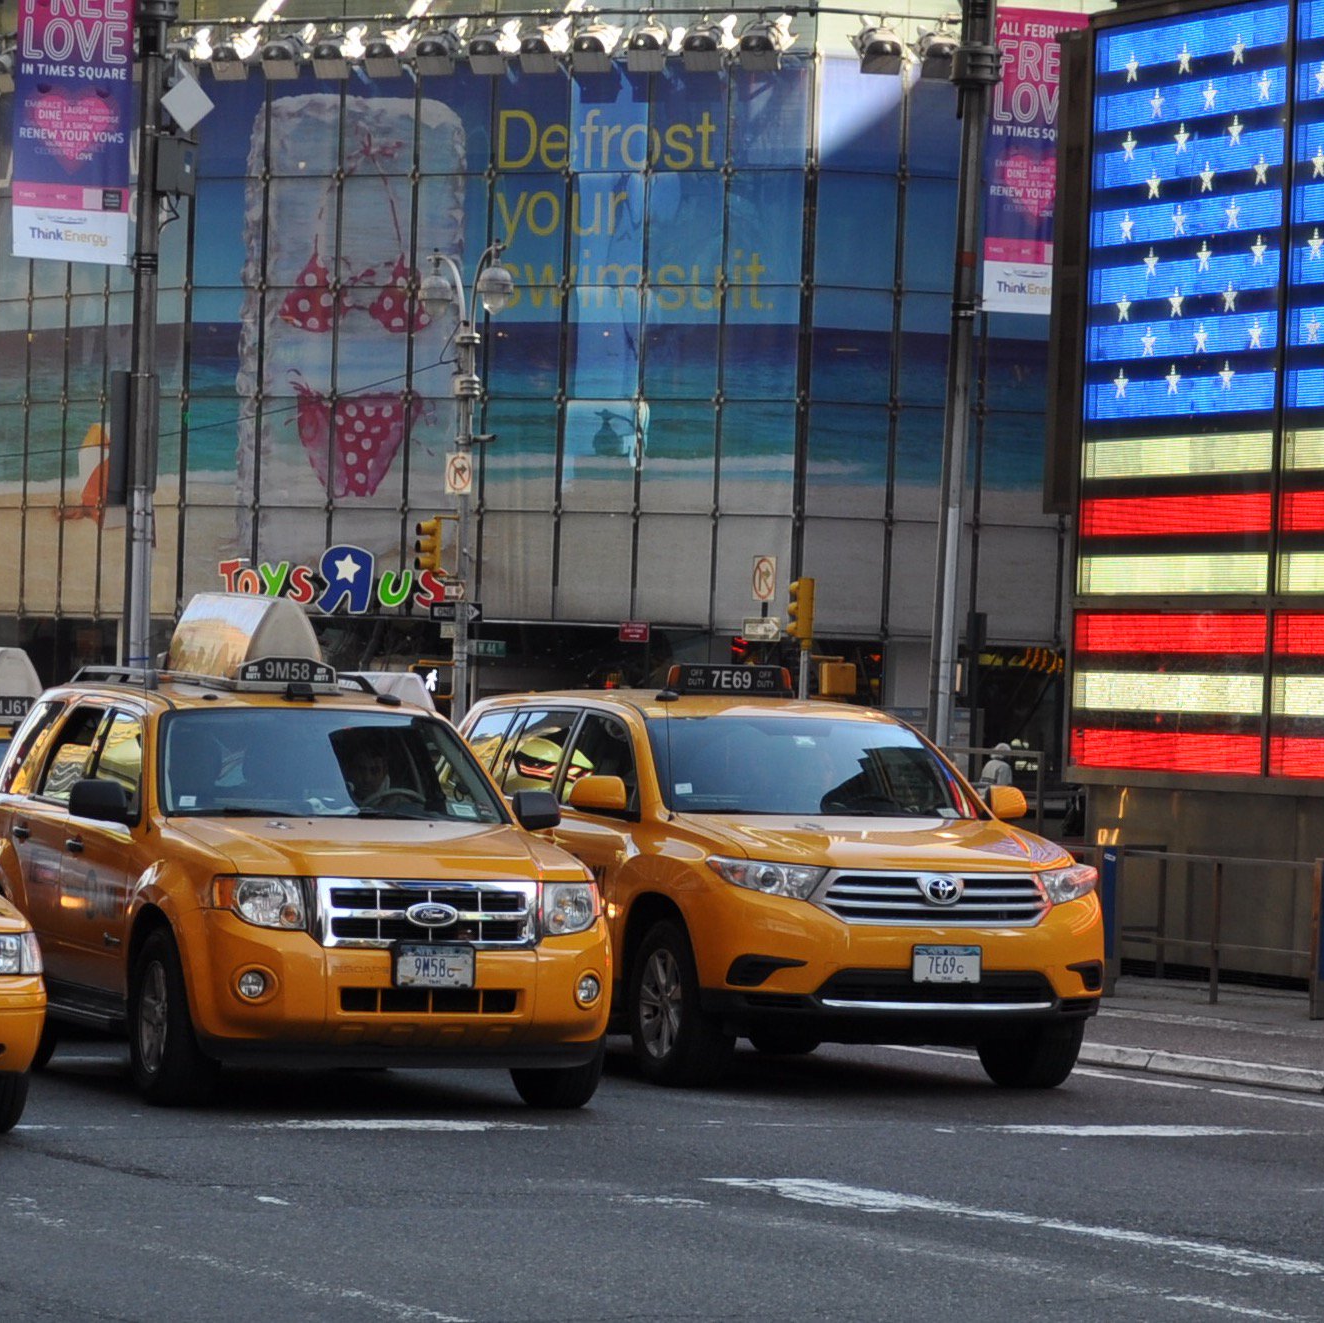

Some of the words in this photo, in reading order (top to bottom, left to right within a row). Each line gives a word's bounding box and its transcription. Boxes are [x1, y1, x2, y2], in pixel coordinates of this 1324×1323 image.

[999, 22, 1020, 36] ALL
[22, 16, 128, 64] LOVE
[998, 39, 1061, 83] FRE
[21, 62, 34, 75] IN
[37, 64, 76, 77] TIMES
[78, 66, 127, 80] SQUARE
[993, 81, 1059, 125] LOV
[38, 109, 62, 120] DINE
[19, 127, 58, 140] RENEW
[60, 130, 90, 142] YOUR
[93, 132, 124, 144] VOWS
[497, 108, 717, 169] Defrost
[992, 124, 1004, 136] IN
[1006, 125, 1040, 138] TIMES
[1042, 128, 1058, 141] SQ
[75, 153, 93, 161] LOVE
[1007, 169, 1027, 179] DINE
[990, 185, 1023, 197] RENEW
[1026, 188, 1051, 199] YOUR
[496, 190, 629, 248] your
[503, 250, 775, 310] swimsuit.
[218, 558, 314, 604] TOYS
[377, 568, 451, 608] US
[245, 672, 261, 680] DUTY
[265, 661, 310, 681] 9M58
[313, 674, 329, 682] DUTY
[690, 669, 704, 677] OFF
[711, 670, 752, 688] 7E69
[687, 678, 705, 686] DUTY
[756, 680, 774, 688] DUTY
[420, 908, 446, 920] Ford
[928, 956, 964, 974] 7E69C
